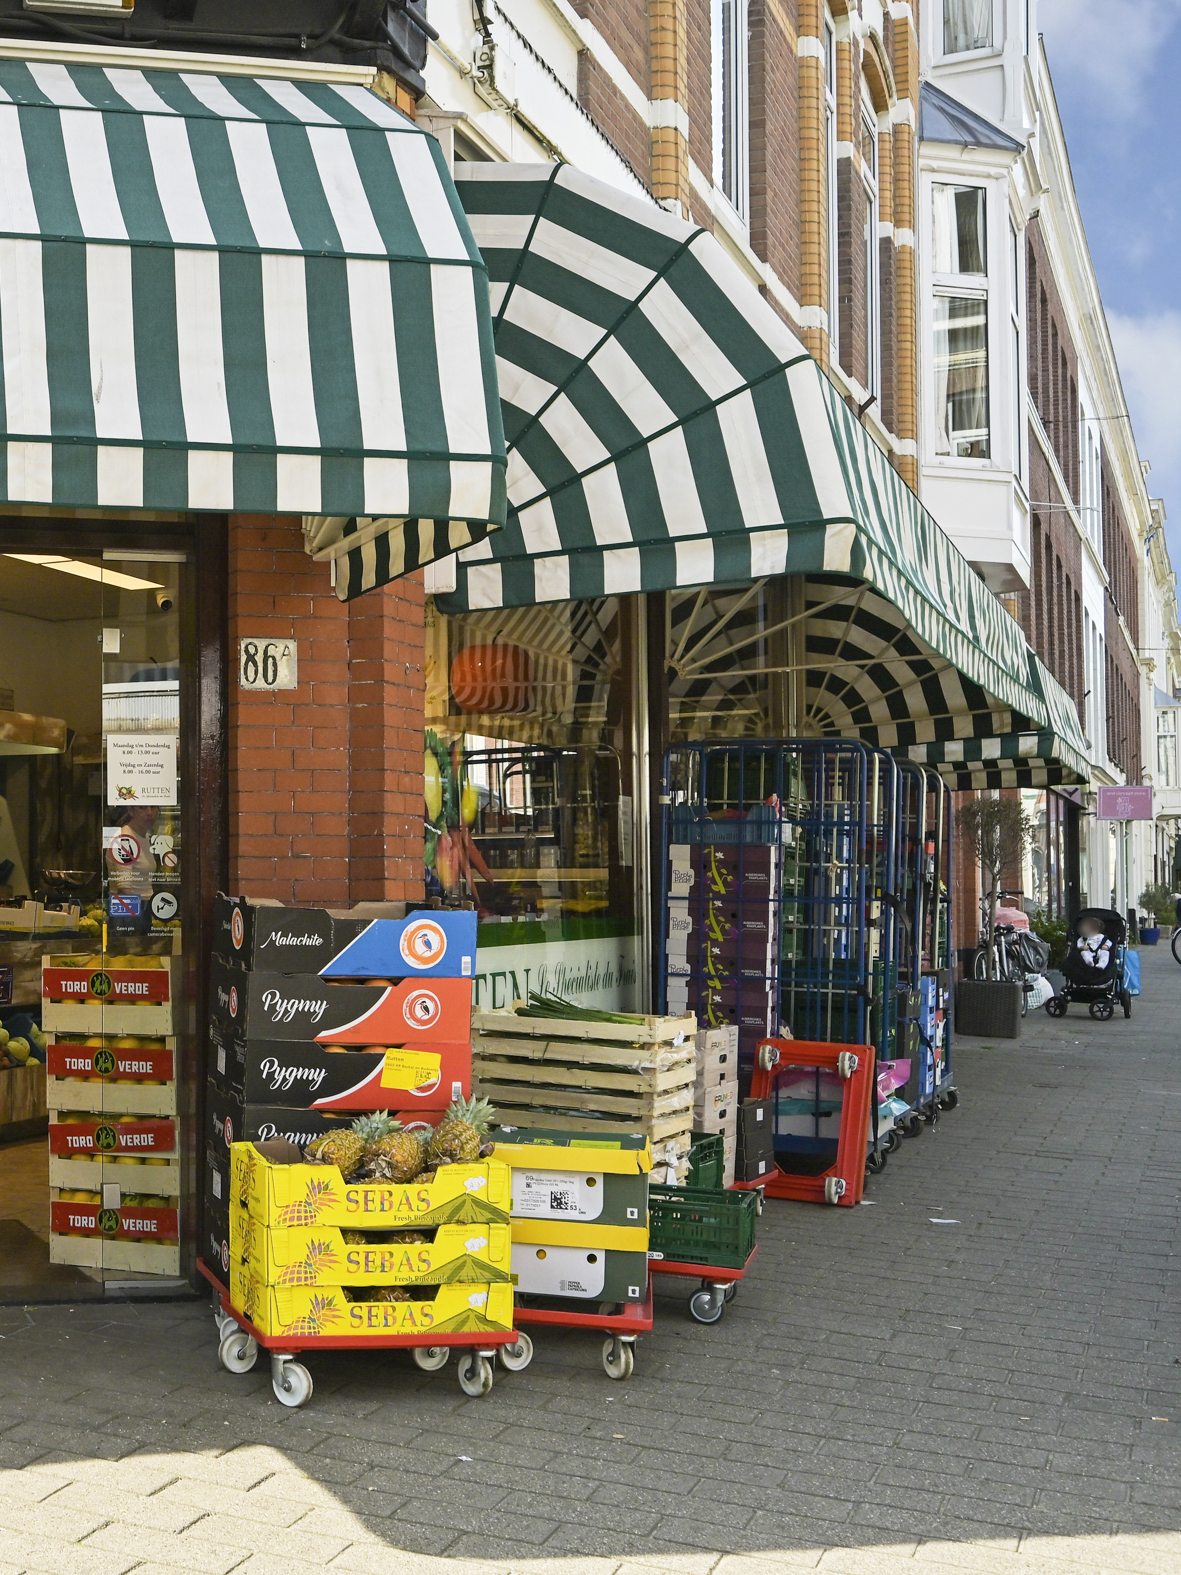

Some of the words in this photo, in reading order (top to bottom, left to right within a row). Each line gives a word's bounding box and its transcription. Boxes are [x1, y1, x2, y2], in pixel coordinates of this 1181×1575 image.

[260, 931, 324, 948] Malachite
[61, 981, 88, 993] TORO
[114, 983, 149, 994] VERDE
[262, 989, 329, 1022] Pygmy
[65, 1058, 92, 1070] TORO
[118, 1061, 153, 1073] VERDE
[260, 1057, 328, 1091] Pygmy
[66, 1136, 93, 1148] TORO
[119, 1134, 154, 1146] VERDE
[346, 1188, 431, 1213] SEBAS
[69, 1215, 95, 1228] TORO
[122, 1219, 157, 1232] VERDE
[393, 1214, 414, 1222] Fresh
[346, 1250, 432, 1274] SEBAS
[394, 1275, 414, 1283] Fresh
[350, 1304, 435, 1329] SEBAS
